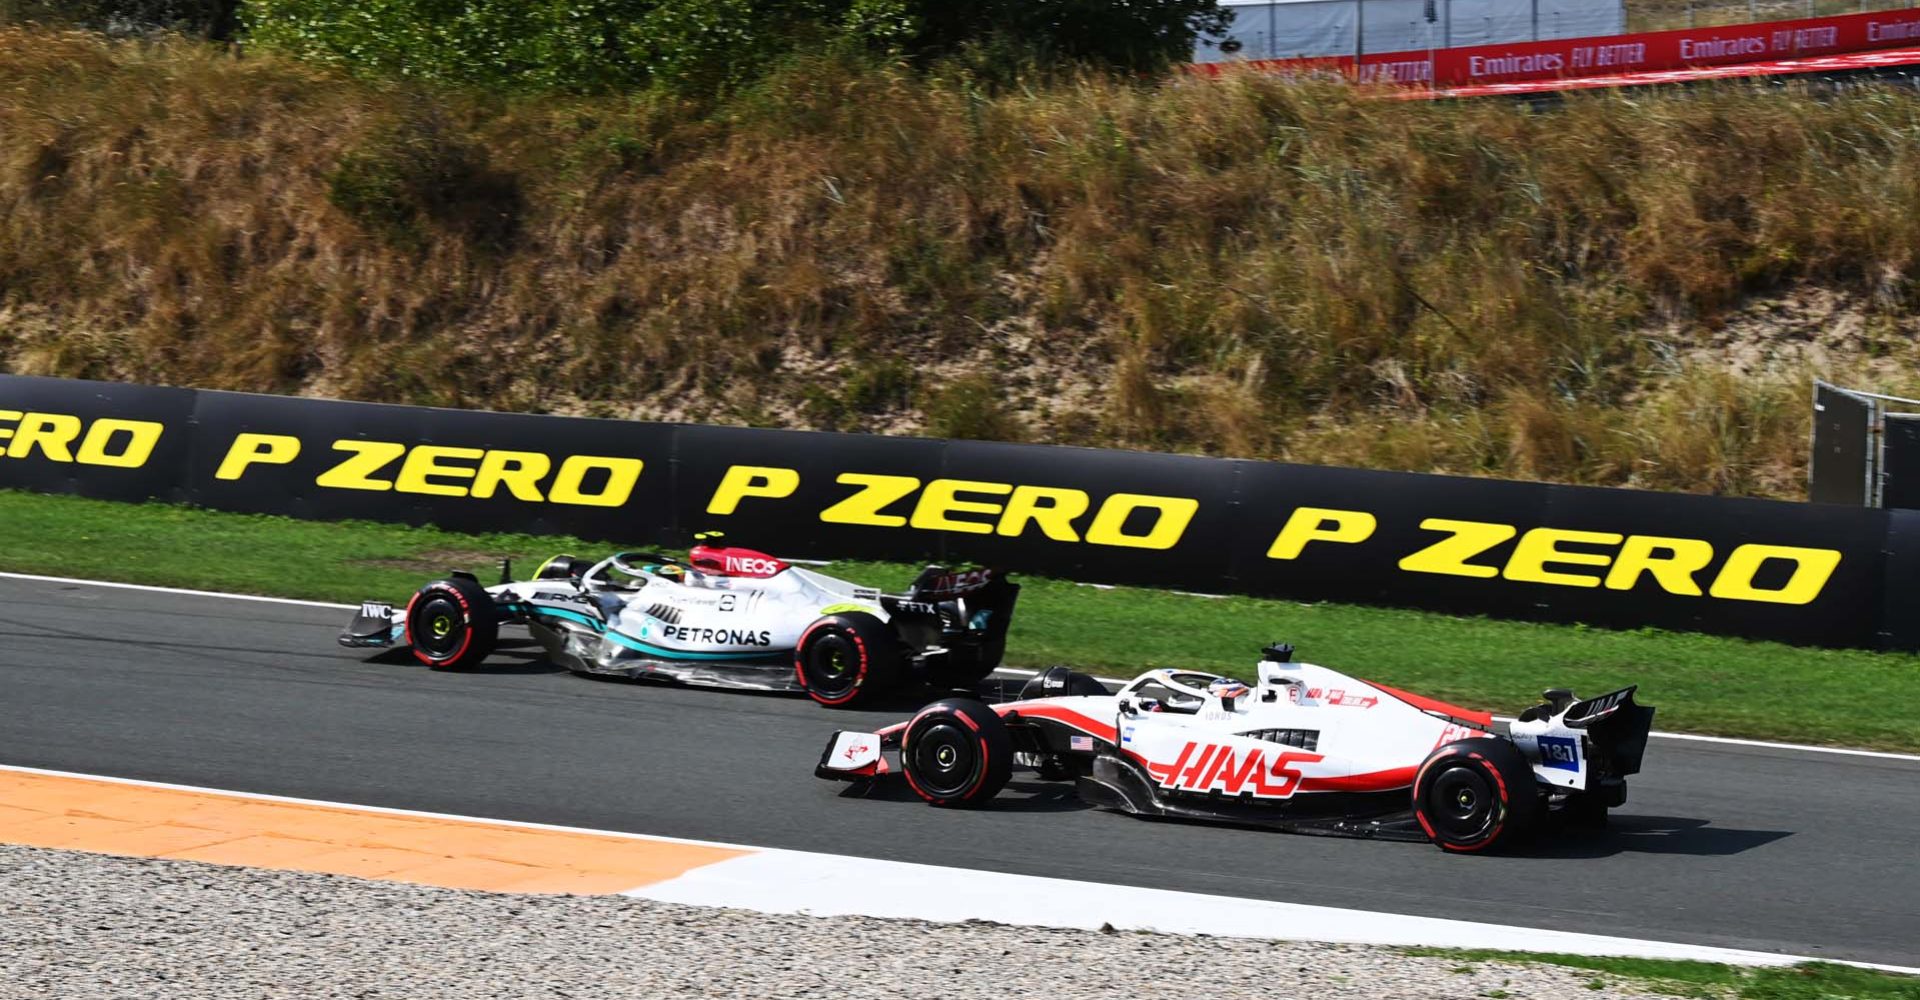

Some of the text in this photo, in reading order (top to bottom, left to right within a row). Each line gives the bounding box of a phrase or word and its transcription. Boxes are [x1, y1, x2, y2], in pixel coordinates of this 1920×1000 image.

[1679, 26, 1838, 59] Emirates FLY BETTER
[1469, 43, 1646, 77] Emirates FLY BETTER
[0, 409, 164, 468] RO
[215, 433, 643, 507] P ZERO
[706, 465, 1198, 550] P ZERO
[726, 555, 779, 575] INEOS
[1266, 507, 1842, 605] P ZERO
[362, 603, 391, 619] IWC
[909, 601, 937, 614] FTX
[663, 625, 771, 646] PETRONAS
[1150, 742, 1326, 797] HAAS
[1540, 743, 1575, 763] 1&1
